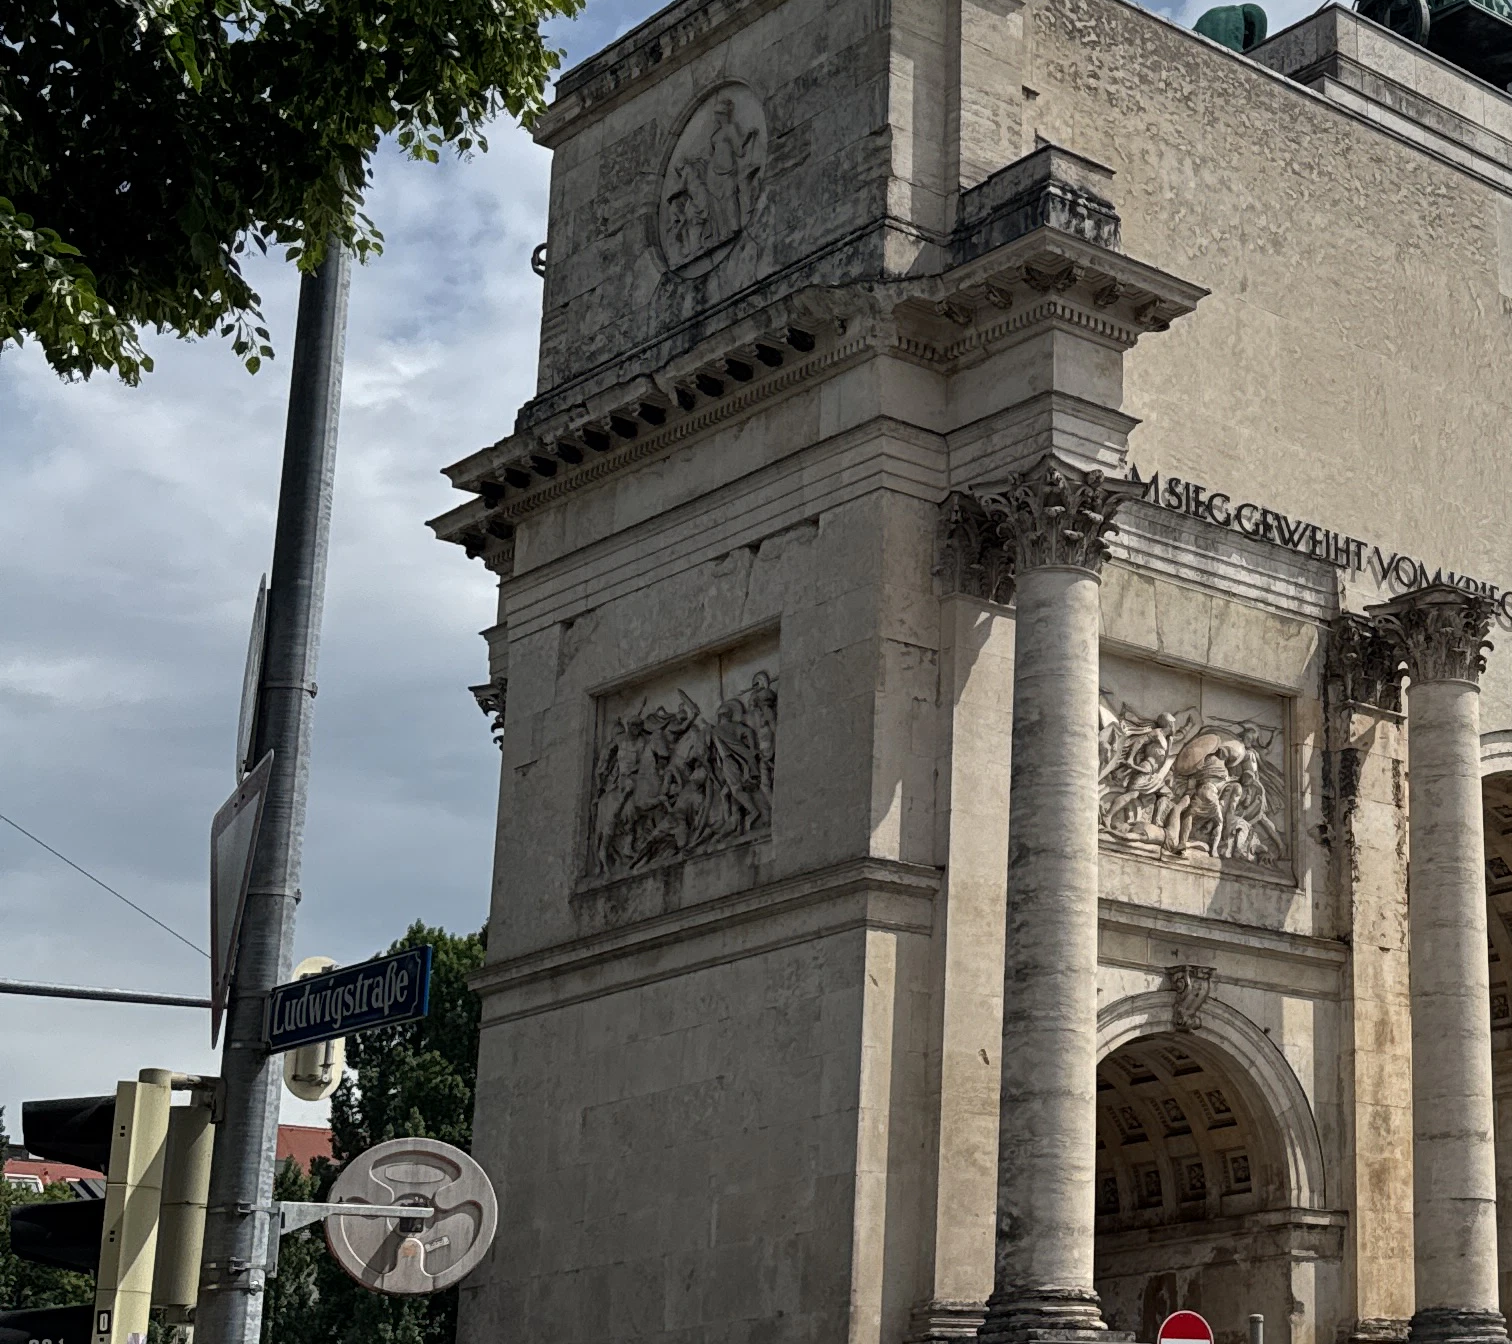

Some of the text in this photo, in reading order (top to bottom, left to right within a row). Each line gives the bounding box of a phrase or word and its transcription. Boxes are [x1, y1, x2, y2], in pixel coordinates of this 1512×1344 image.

[1166, 477, 1231, 527] SIEG
[1235, 503, 1367, 571] GEWEIHT
[272, 960, 409, 1036] Ludwigstraße
